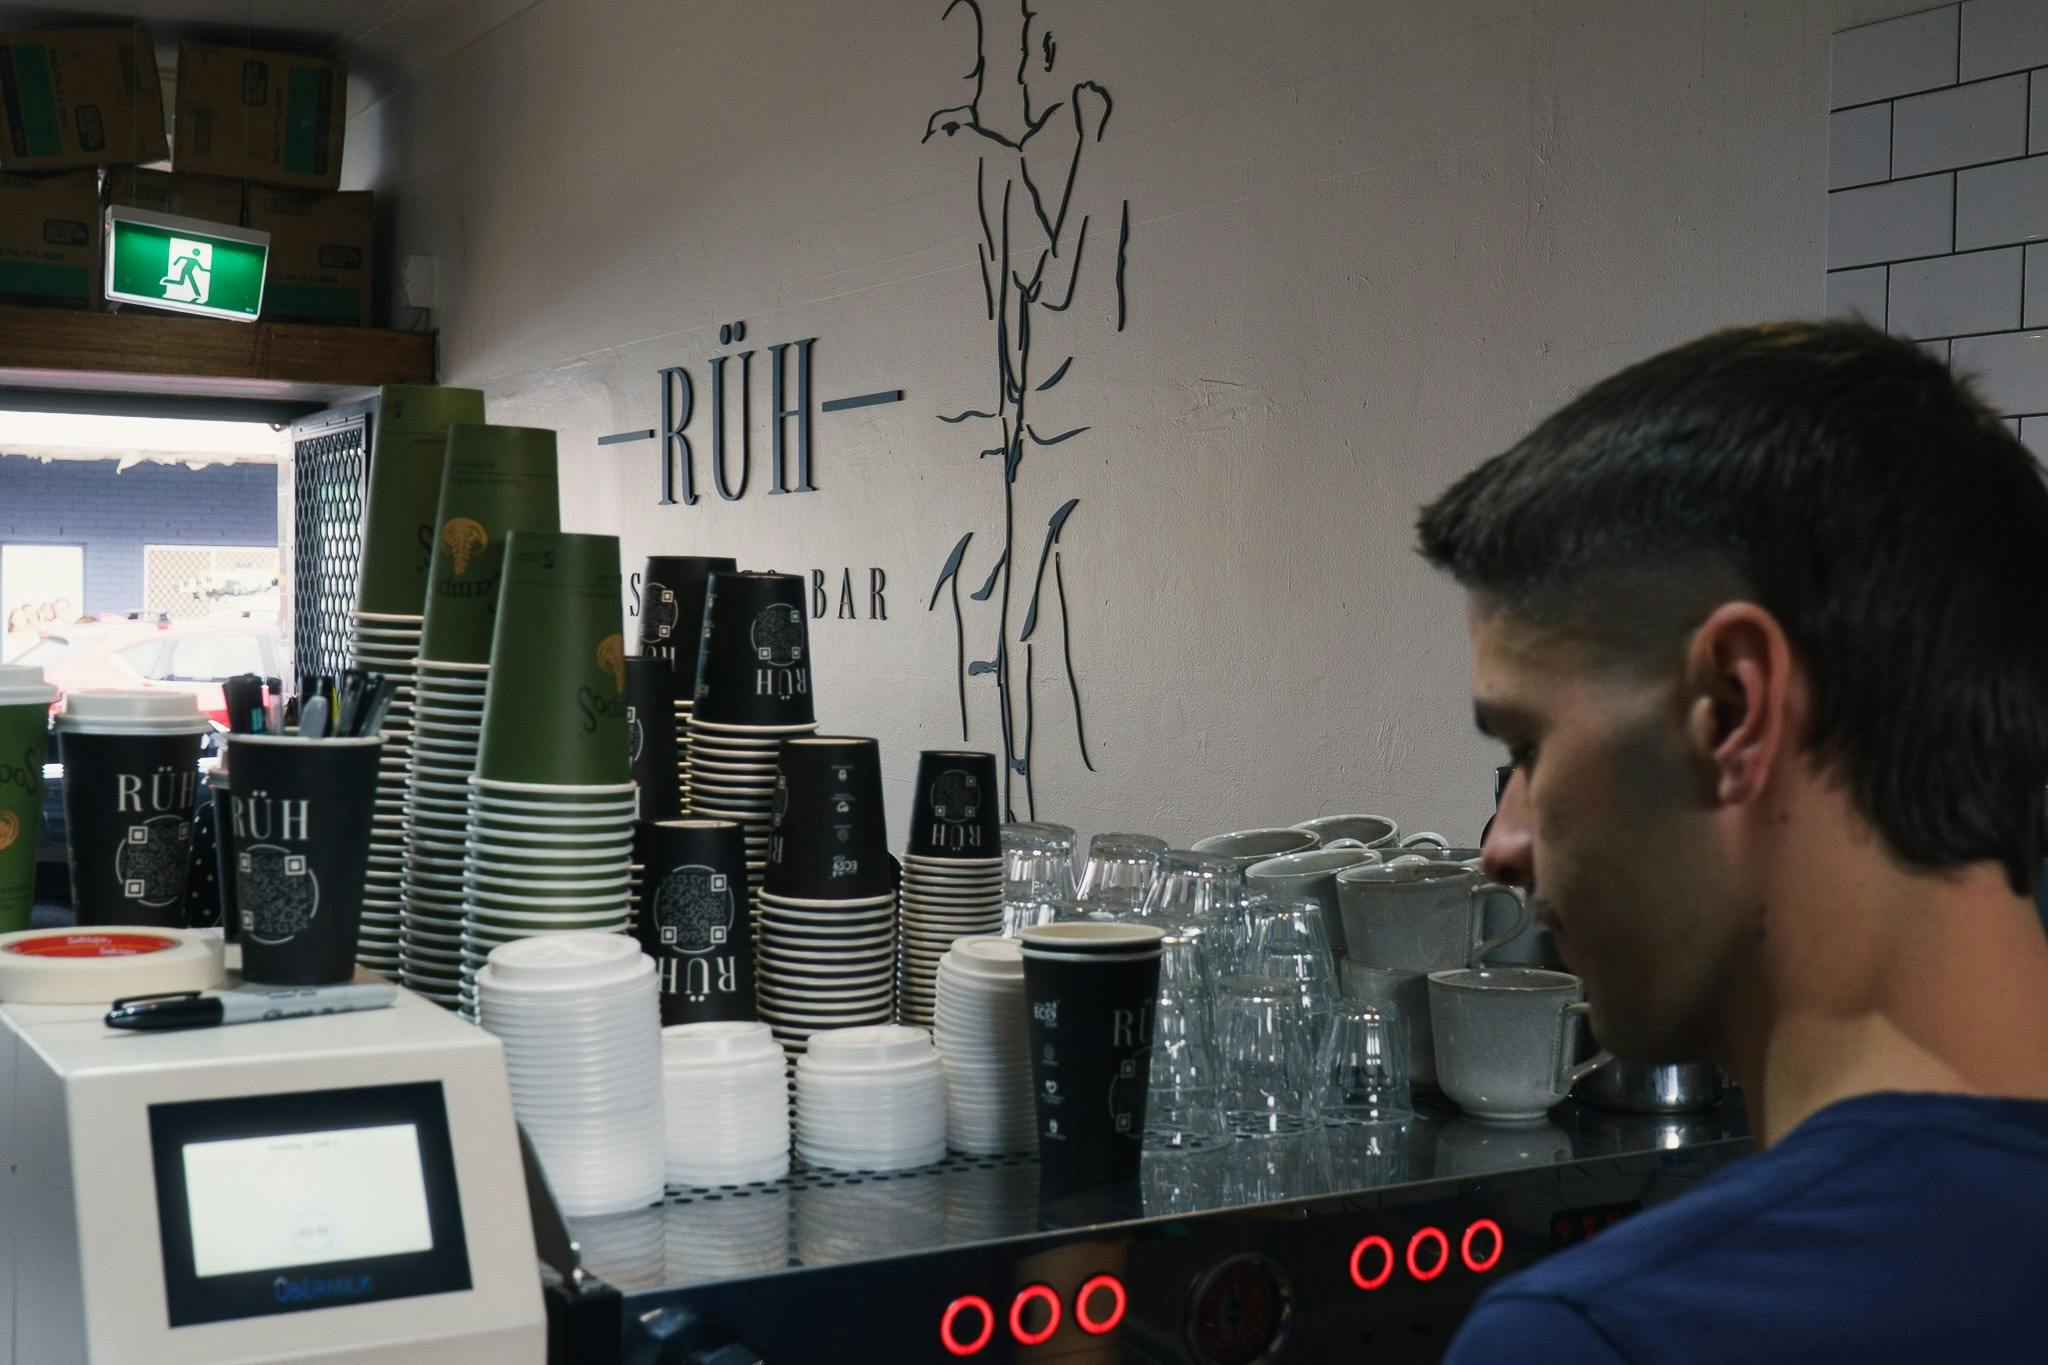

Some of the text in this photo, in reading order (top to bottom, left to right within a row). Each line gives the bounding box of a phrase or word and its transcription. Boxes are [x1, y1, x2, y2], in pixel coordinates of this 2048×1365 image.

[658, 320, 820, 505] RÜH
[811, 567, 888, 621] BAR
[756, 668, 807, 700] RÜH
[116, 766, 195, 812] RÜH
[231, 789, 312, 841] RÜH
[931, 823, 981, 851] RÜH
[656, 955, 737, 1002] RÜH
